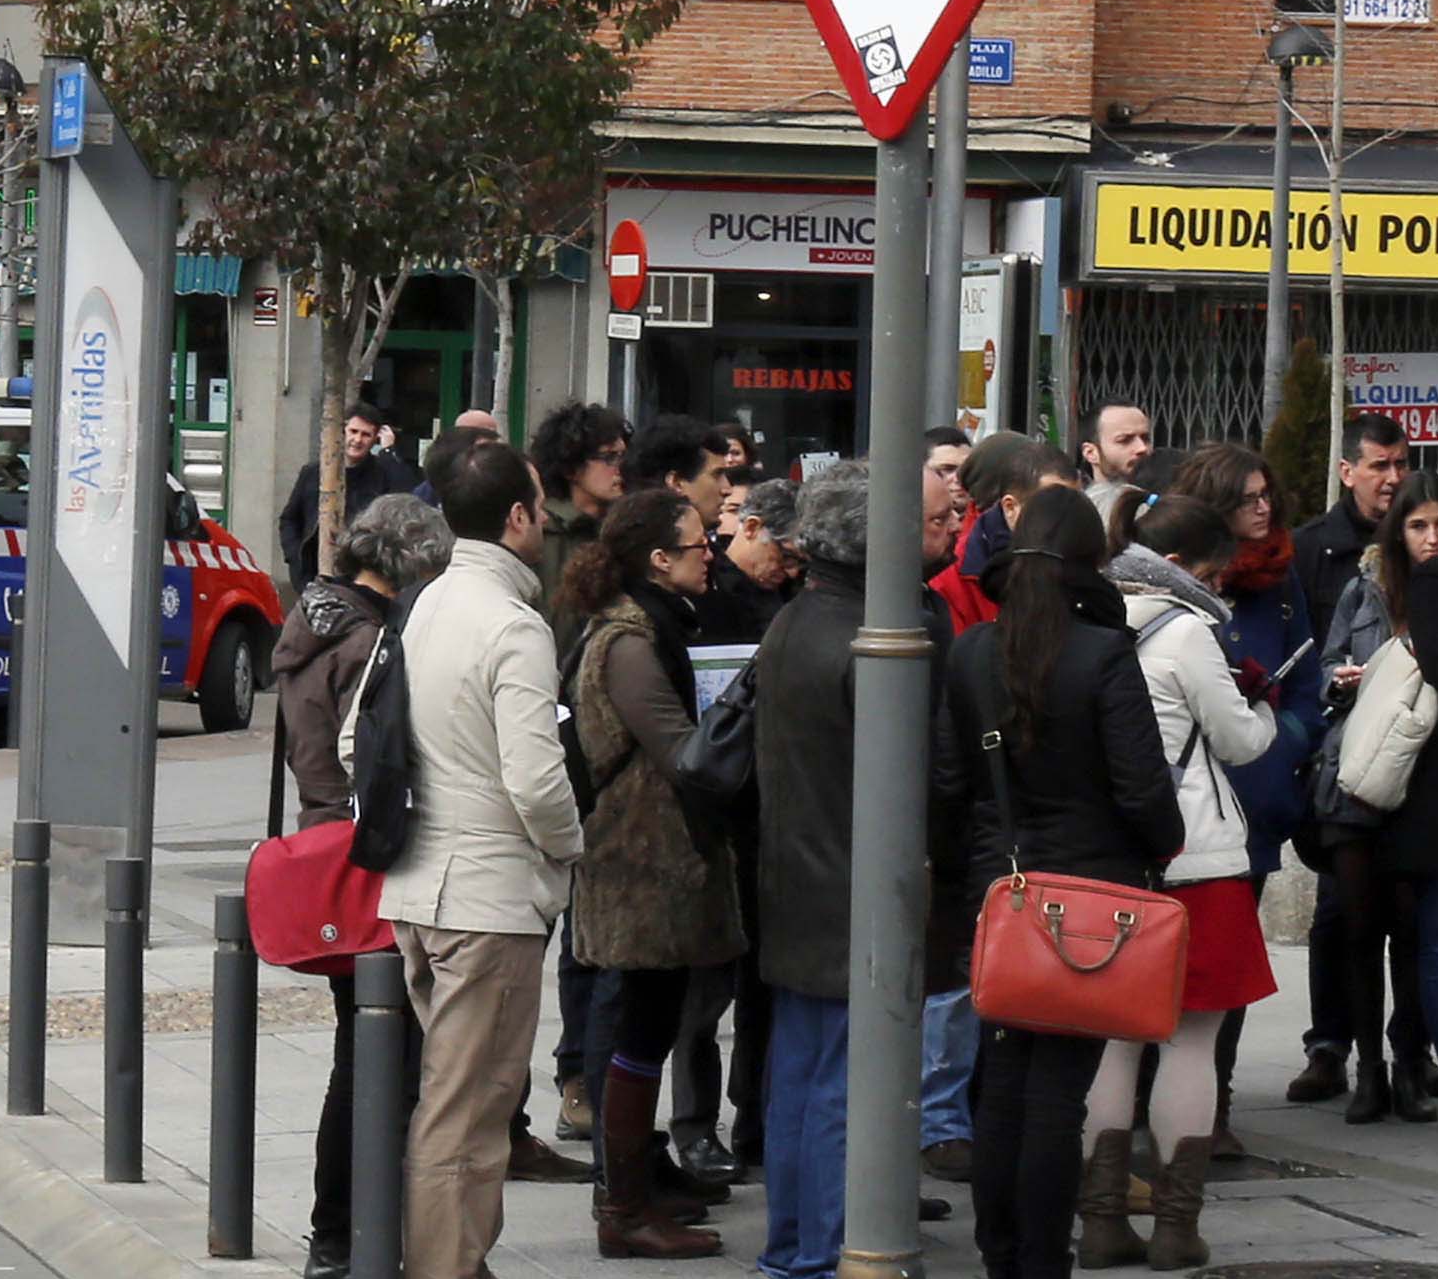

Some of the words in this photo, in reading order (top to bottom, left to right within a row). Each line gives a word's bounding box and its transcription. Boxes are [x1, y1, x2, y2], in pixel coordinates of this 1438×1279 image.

[969, 66, 1004, 78] ADILLO
[1129, 204, 1357, 253] LIQUIDAIÓN
[827, 251, 872, 262] JOVEN
[733, 368, 852, 392] REBAJAS
[68, 331, 107, 489] Avenidas
[65, 485, 85, 513] las
